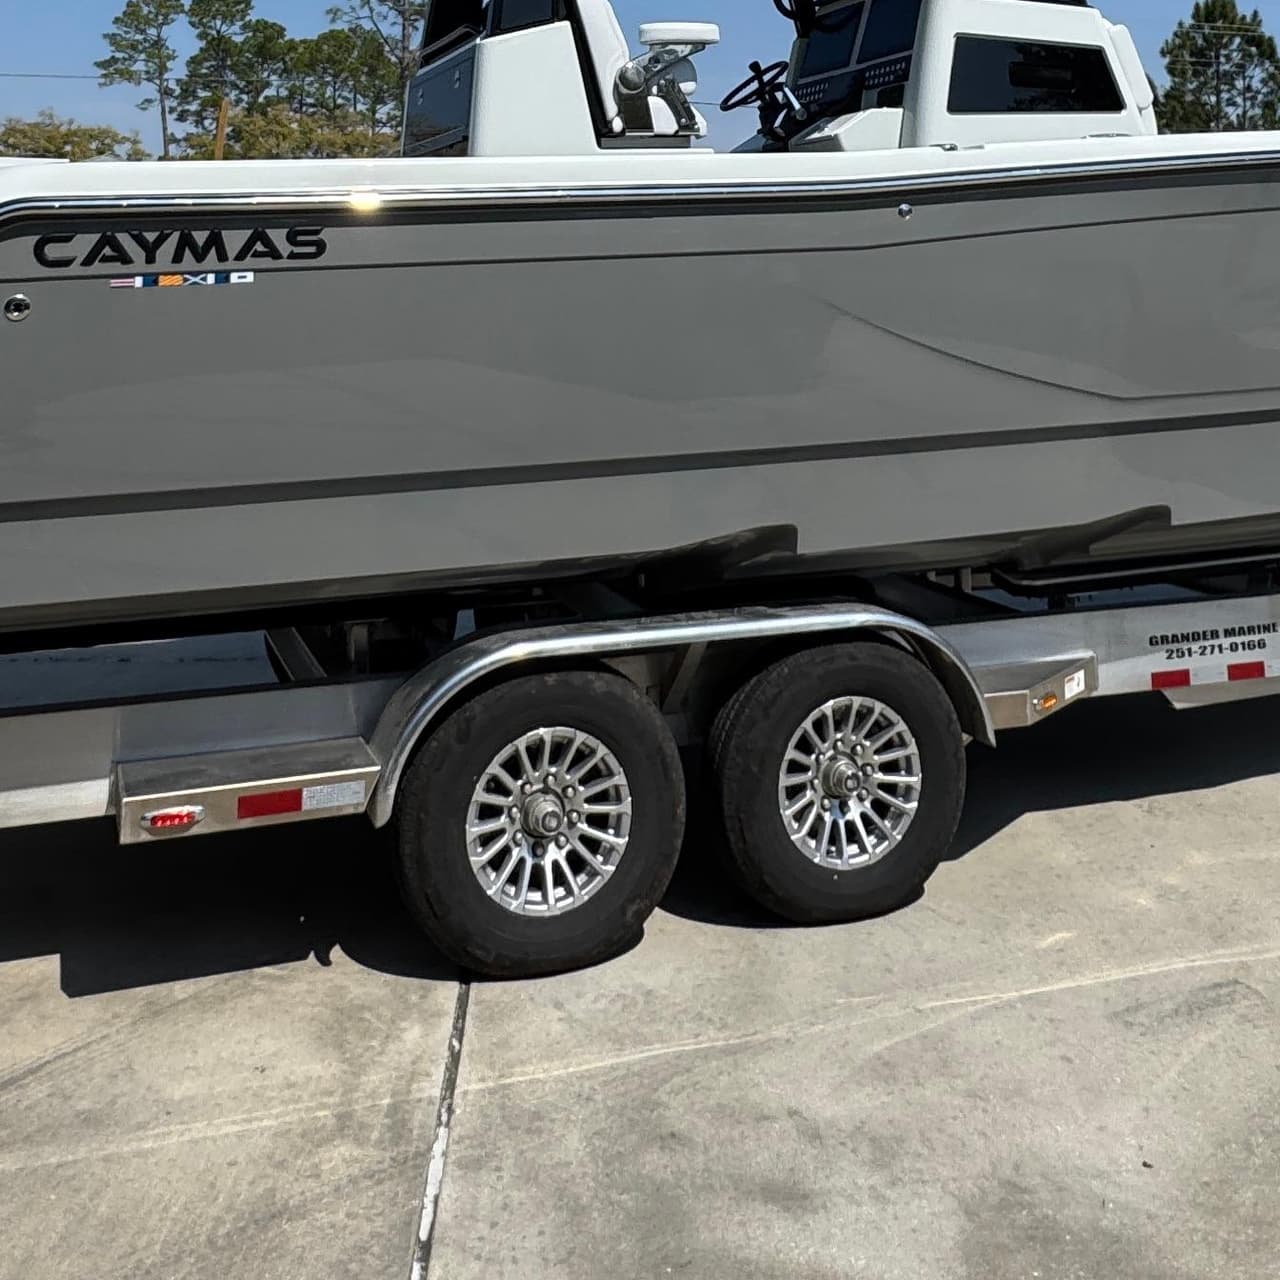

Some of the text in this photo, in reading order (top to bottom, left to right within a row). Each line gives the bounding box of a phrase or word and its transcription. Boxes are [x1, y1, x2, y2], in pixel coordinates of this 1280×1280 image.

[33, 226, 327, 268] CAYMAS
[1148, 622, 1279, 647] GRANDER MARINE
[1165, 638, 1267, 660] 251-271-0166
